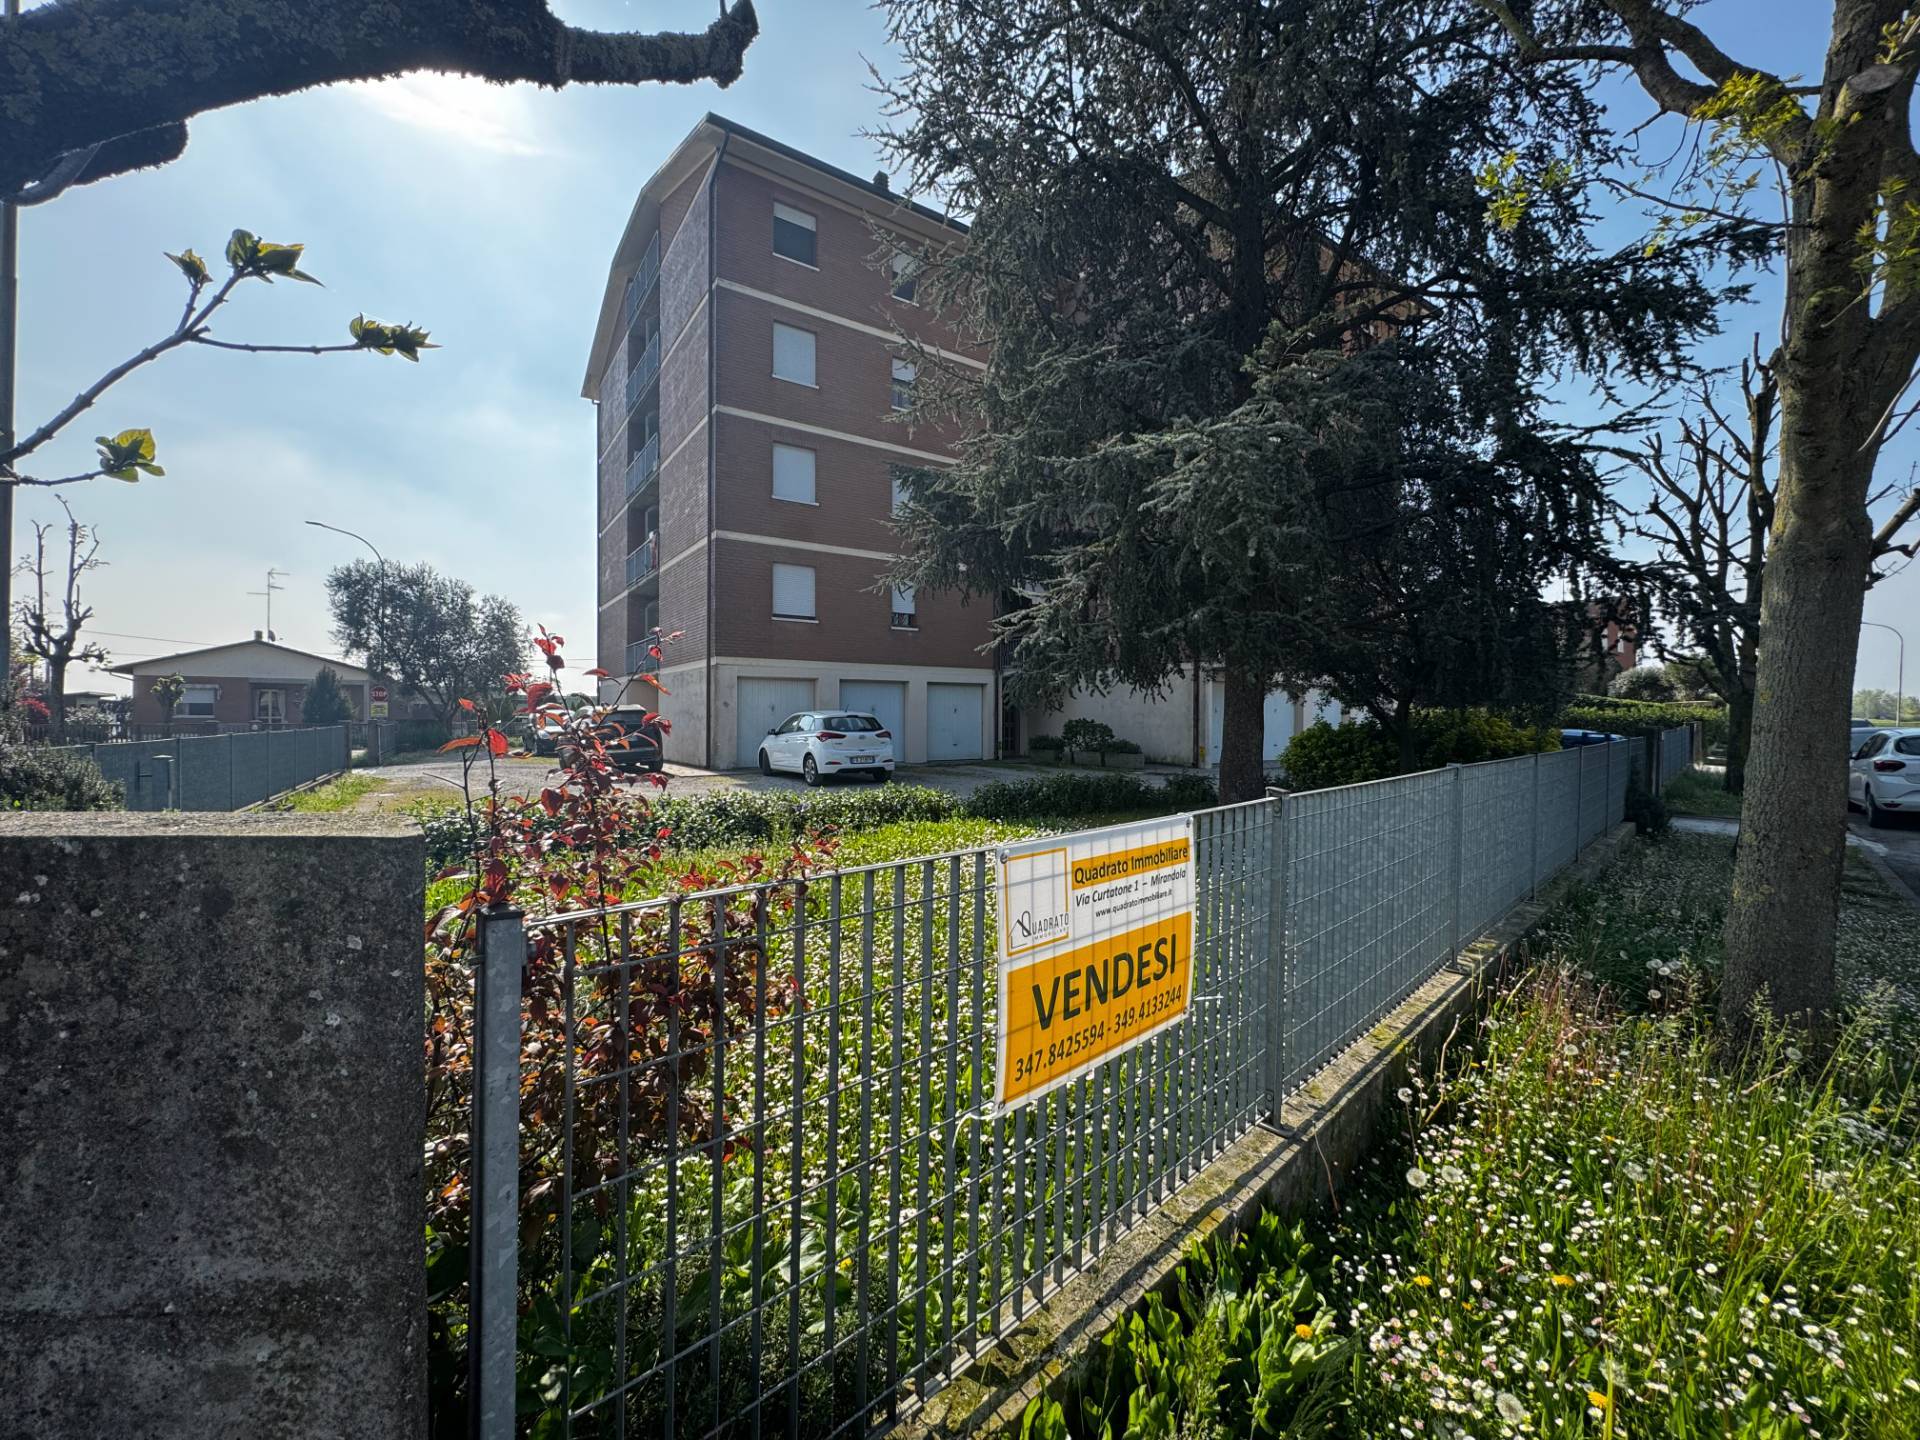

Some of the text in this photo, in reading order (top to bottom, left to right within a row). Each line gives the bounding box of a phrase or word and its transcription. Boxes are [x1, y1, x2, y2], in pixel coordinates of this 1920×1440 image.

[1074, 848, 1188, 885] Quadrato Immobiliare
[1076, 892, 1090, 907] Via
[1092, 883, 1132, 903] Curtatone
[1134, 880, 1139, 891] 1
[1151, 868, 1186, 886] Mirandola
[1096, 890, 1172, 917] www.quadratoimmobiliare.it
[1018, 910, 1069, 938] QUADRATO
[1032, 934, 1176, 1031] VENDESI
[1015, 1021, 1104, 1081] 347.8425594
[1114, 985, 1182, 1034] 349.4133244
